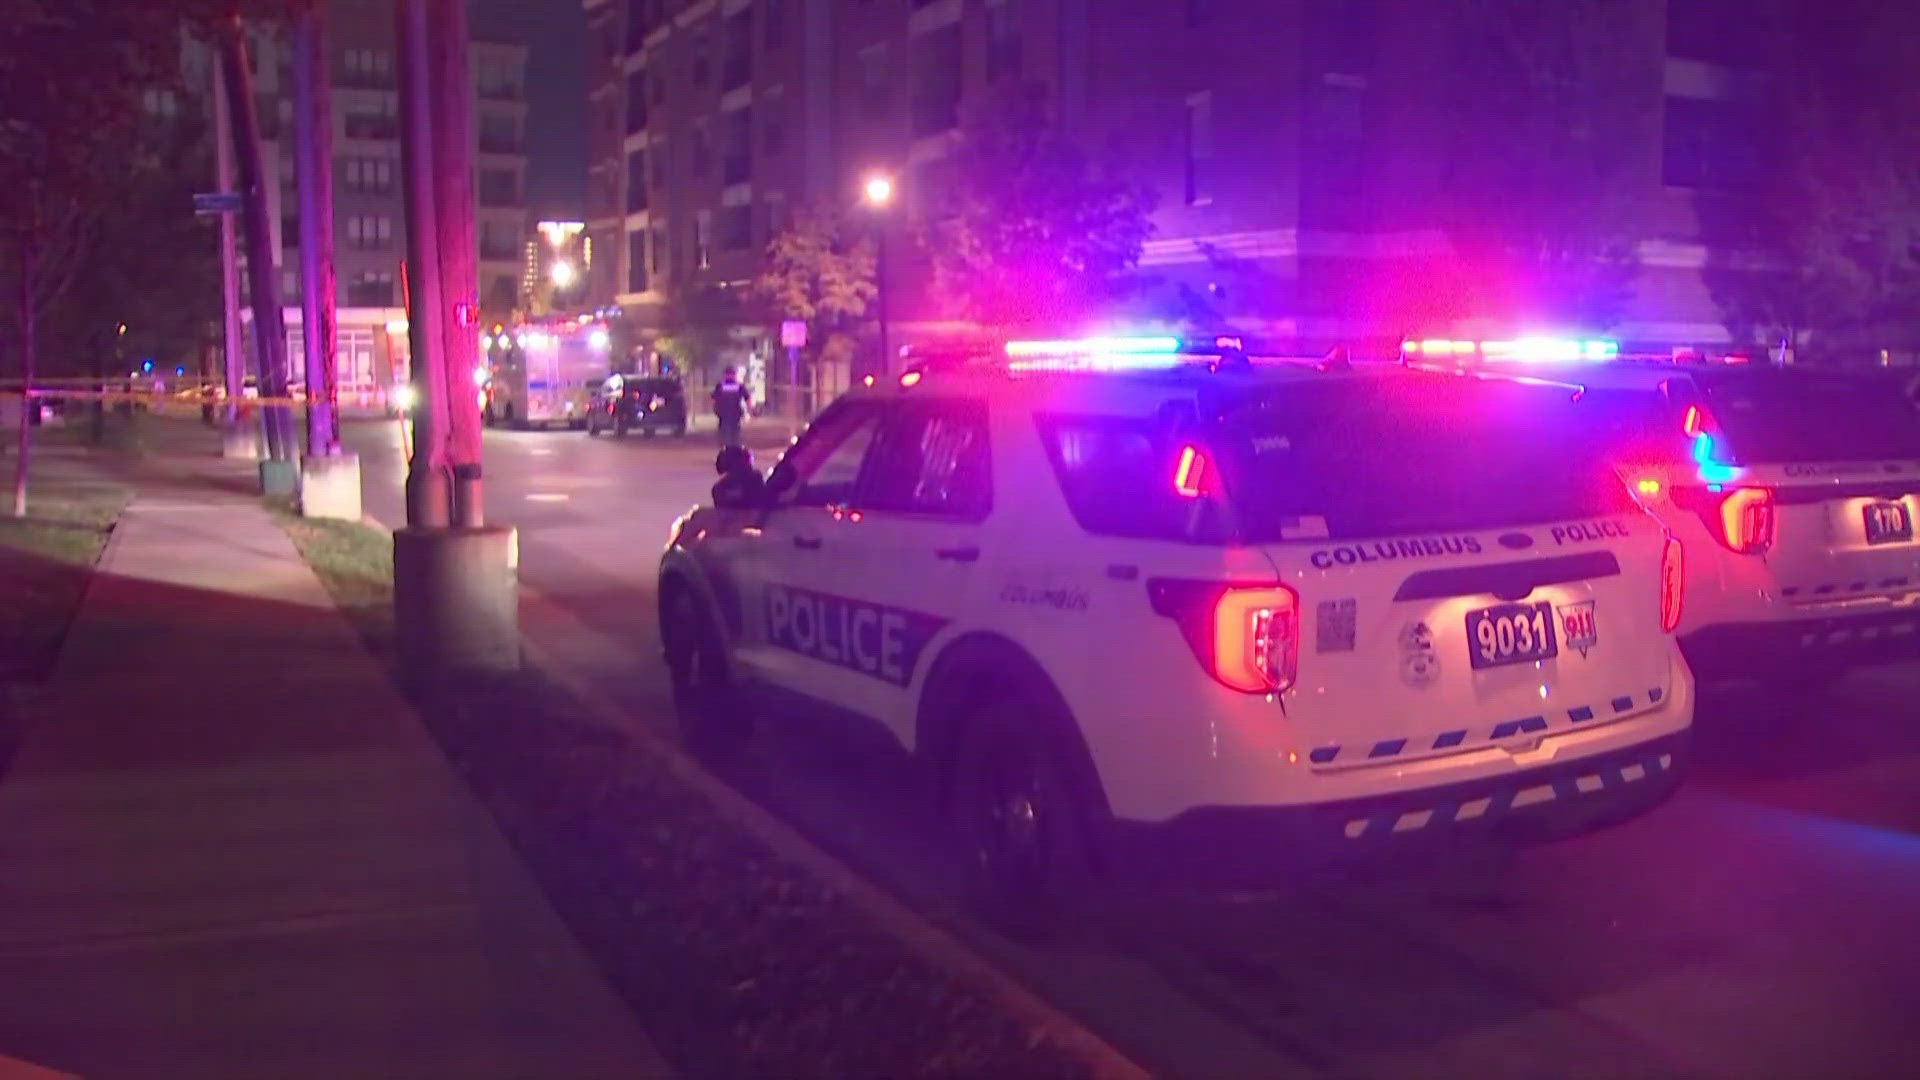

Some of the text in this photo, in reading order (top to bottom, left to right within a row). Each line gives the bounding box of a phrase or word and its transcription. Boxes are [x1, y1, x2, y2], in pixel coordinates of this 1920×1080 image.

[1310, 519, 1629, 569] COLUMBUS POLICE
[1875, 507, 1903, 534] 170
[770, 586, 906, 679] POLICE
[1477, 612, 1549, 659] 9031
[1566, 612, 1593, 638] 911
